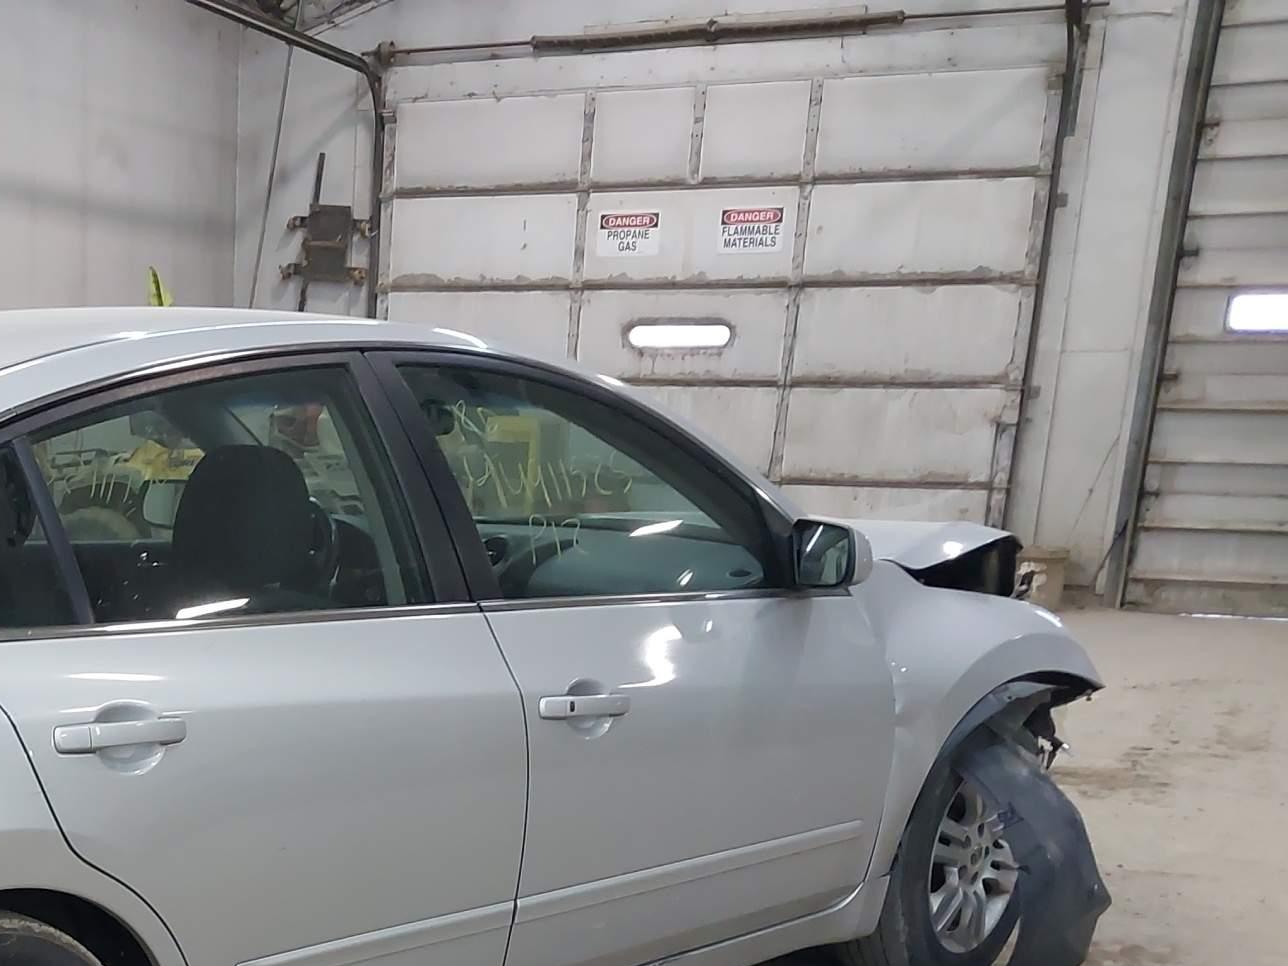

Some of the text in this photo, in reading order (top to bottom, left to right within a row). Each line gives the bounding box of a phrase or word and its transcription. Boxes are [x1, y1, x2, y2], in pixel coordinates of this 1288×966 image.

[608, 215, 650, 227] DANGER
[730, 210, 774, 222] DANGER
[607, 229, 650, 240] PROPANE
[721, 225, 780, 236] FLAMMABLE
[617, 241, 637, 251] GAS
[723, 237, 777, 249] MATERIALS
